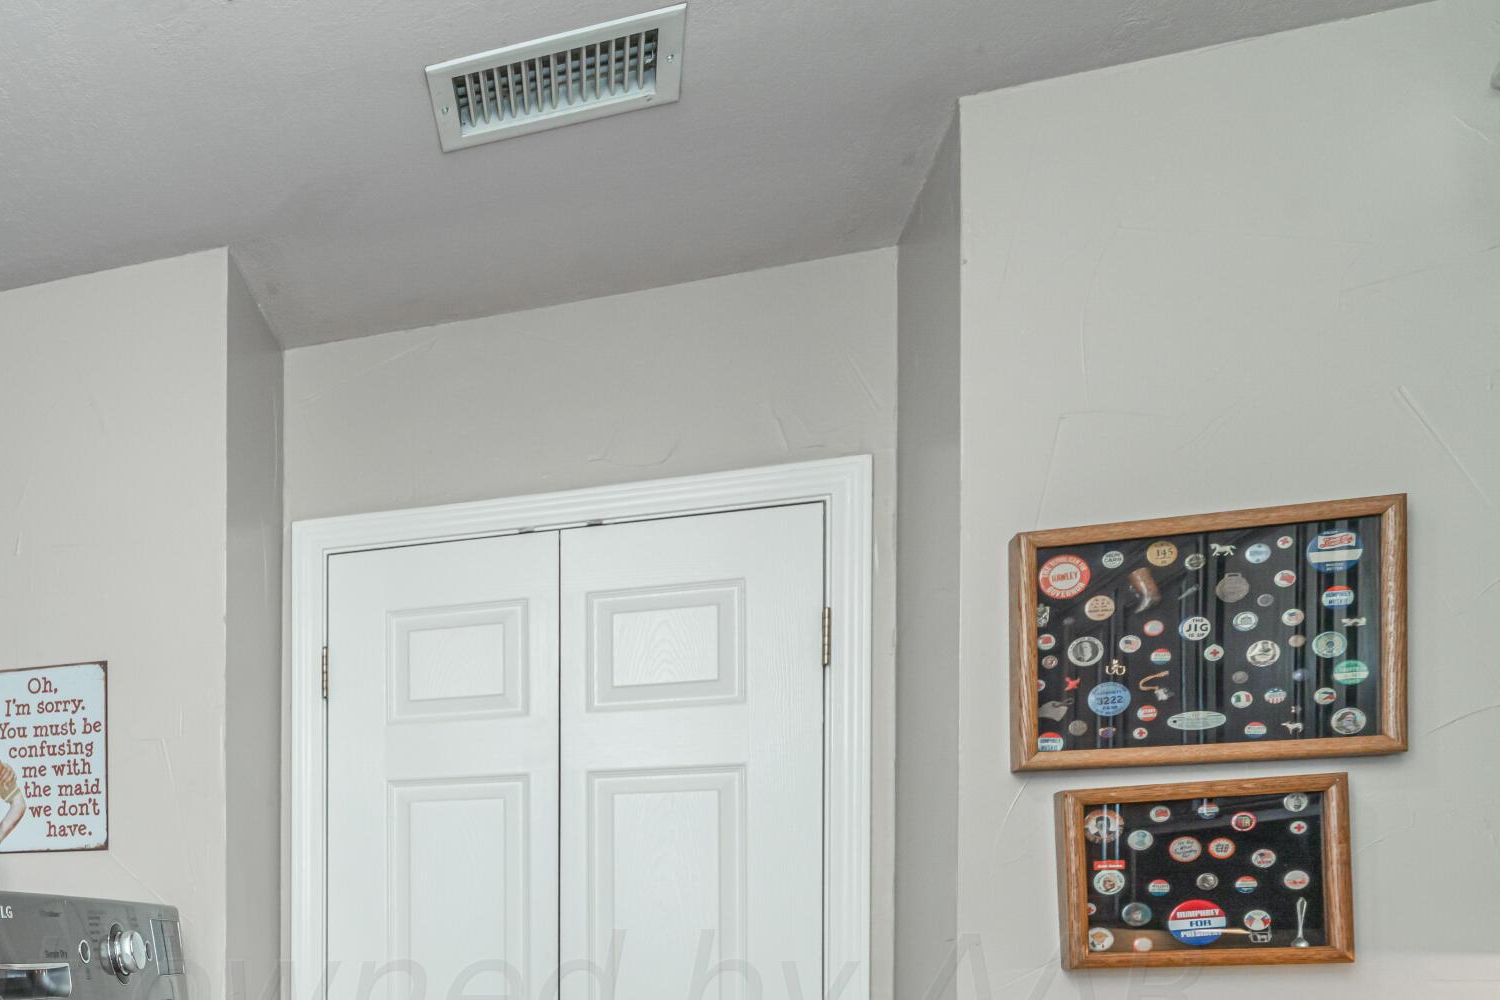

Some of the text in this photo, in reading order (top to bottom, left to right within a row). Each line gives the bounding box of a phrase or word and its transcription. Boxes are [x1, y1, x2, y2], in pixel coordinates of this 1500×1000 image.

[1155, 548, 1174, 558] 145
[1185, 623, 1209, 633] JIG
[27, 677, 58, 695] Oh,
[5, 698, 86, 717] I'm sorry.
[32, 719, 77, 738] must
[81, 717, 102, 735] be
[8, 740, 94, 759] confusing
[21, 759, 92, 779] me with
[23, 778, 102, 799] the maid
[28, 798, 100, 818] we don't
[46, 820, 93, 838] have.
[0, 905, 14, 919] LG
[1176, 908, 1220, 919] HUMPHREY
[1189, 919, 1212, 928] FOR
